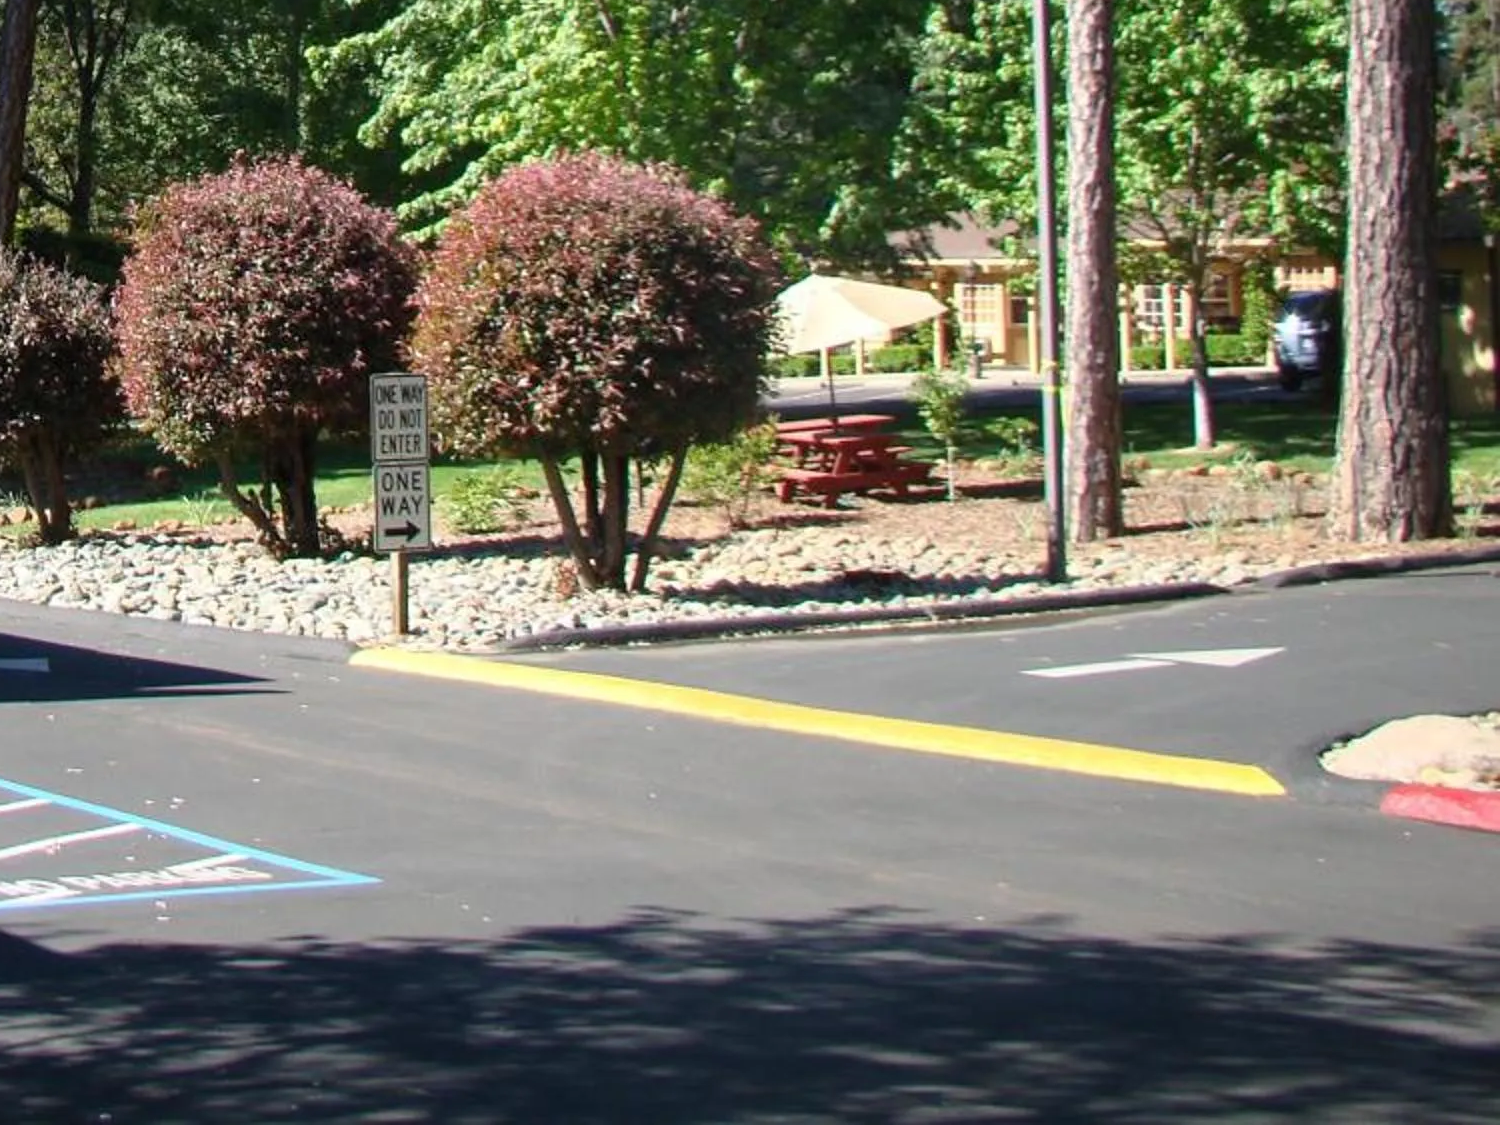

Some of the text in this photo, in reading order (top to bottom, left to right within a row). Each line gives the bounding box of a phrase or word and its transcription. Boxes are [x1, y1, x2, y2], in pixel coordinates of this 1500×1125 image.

[375, 384, 424, 404] ONE WAY
[378, 408, 422, 429] DO NOT
[380, 434, 421, 454] ENTER
[381, 471, 422, 492] ONE
[381, 495, 424, 516] WAY
